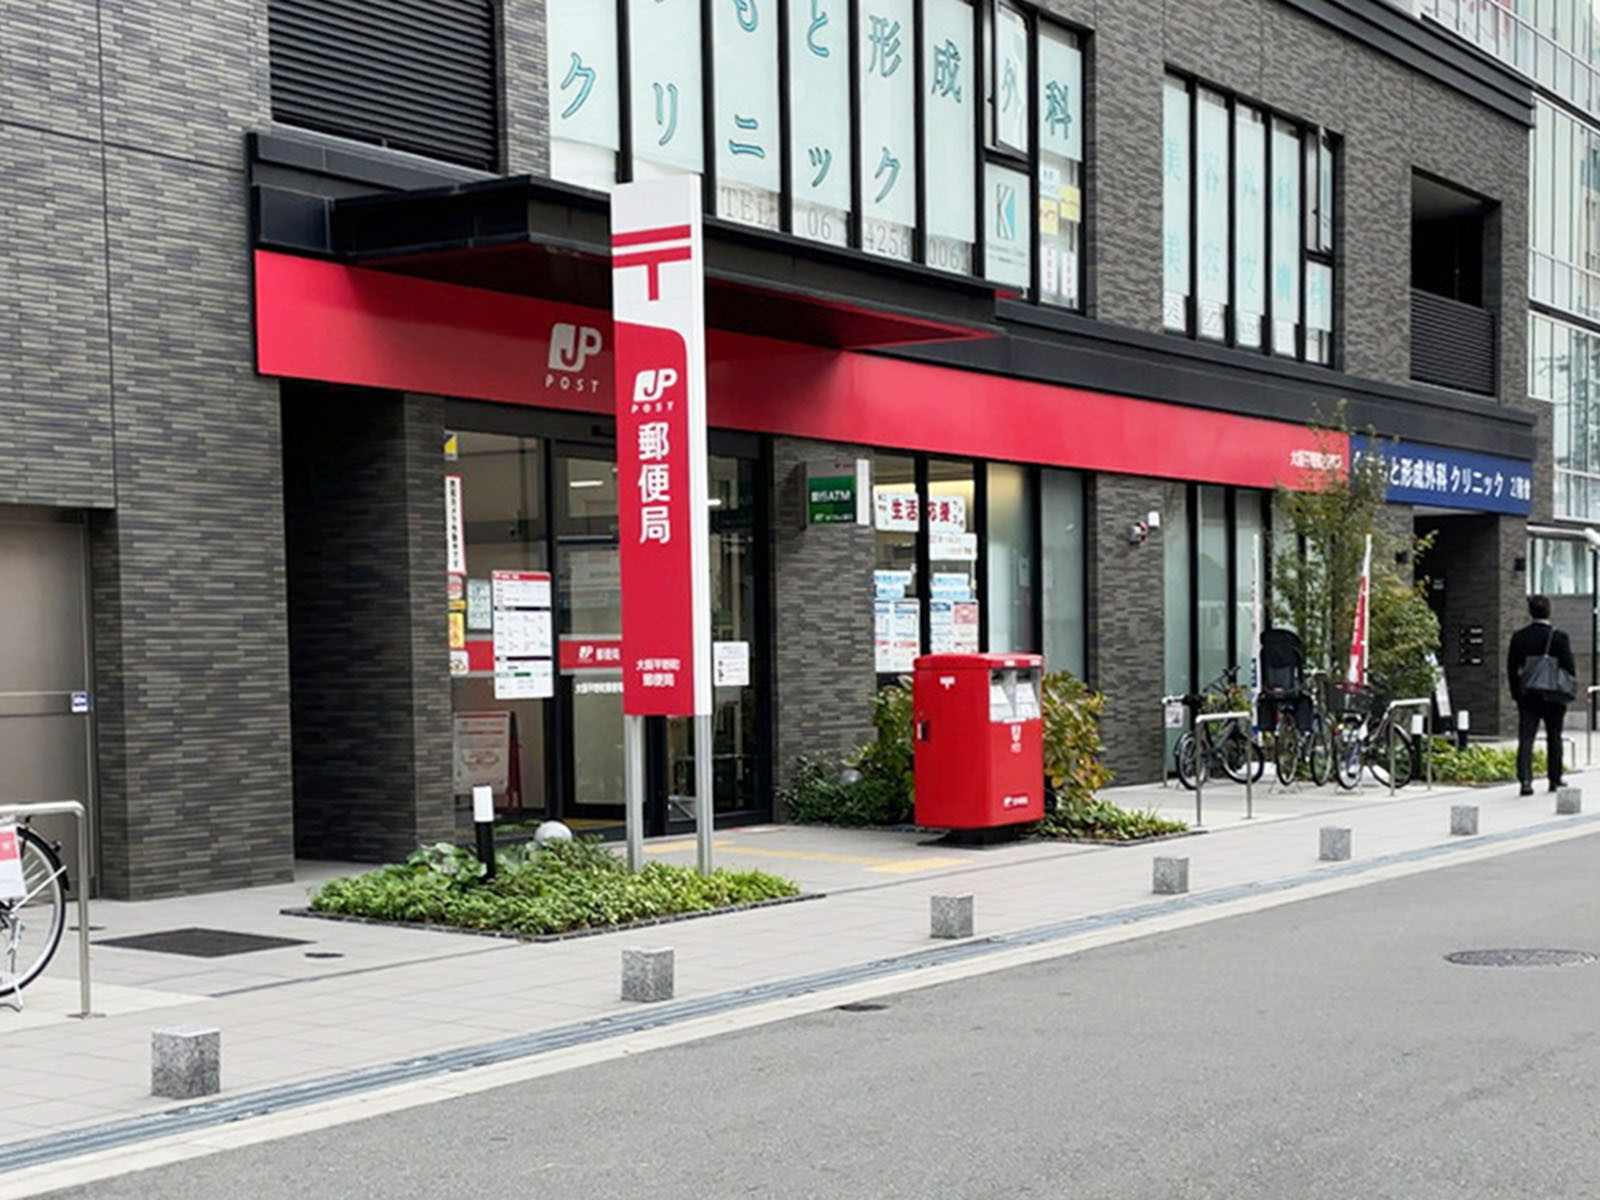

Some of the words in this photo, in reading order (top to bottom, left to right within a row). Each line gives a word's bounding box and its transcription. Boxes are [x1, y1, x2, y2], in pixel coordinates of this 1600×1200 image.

[561, 52, 901, 204] クリニック
[807, 206, 832, 242] 06
[929, 237, 970, 272] 006
[546, 376, 599, 392] POST
[631, 402, 675, 413] POST
[638, 421, 671, 544] 郵便局
[1450, 465, 1504, 498] クリニック
